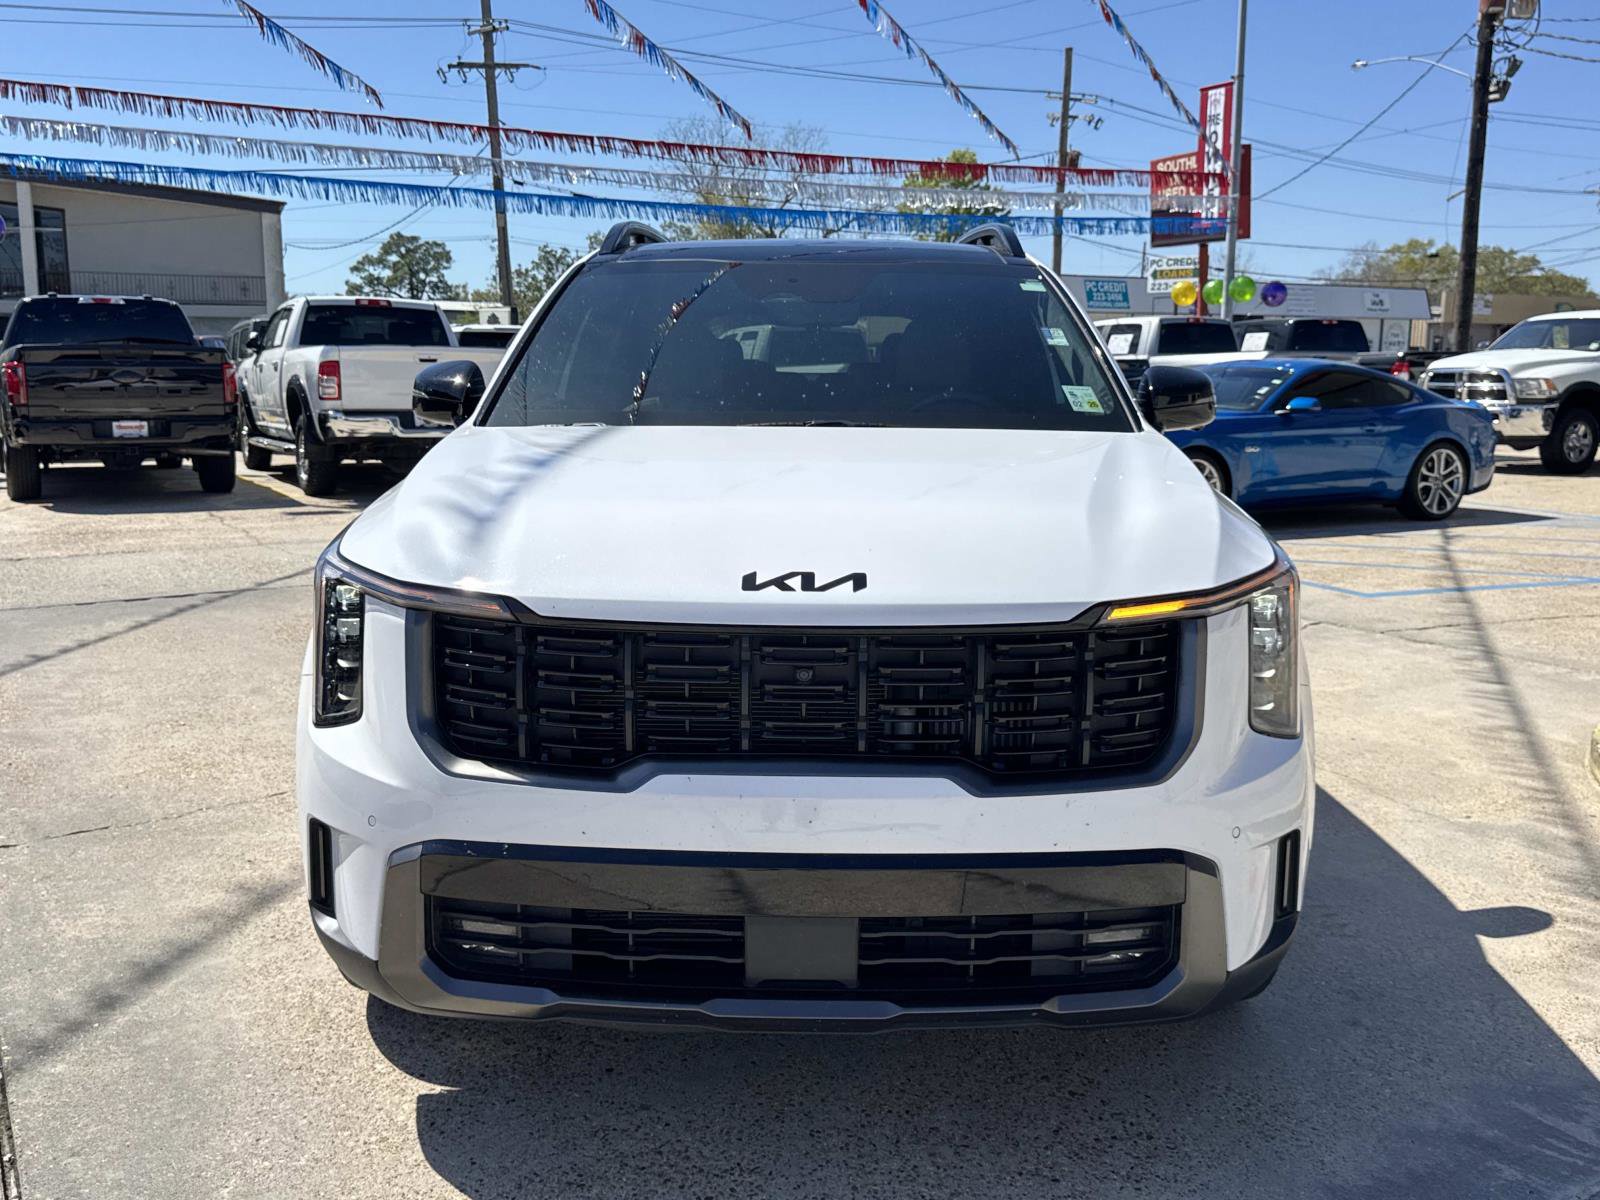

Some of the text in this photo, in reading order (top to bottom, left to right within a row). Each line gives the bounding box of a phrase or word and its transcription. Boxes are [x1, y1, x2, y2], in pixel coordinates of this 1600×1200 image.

[1150, 259, 1163, 268] PC
[1156, 269, 1193, 279] LOANS
[1085, 281, 1127, 293] PC CREDIT
[741, 571, 867, 593] KIA
